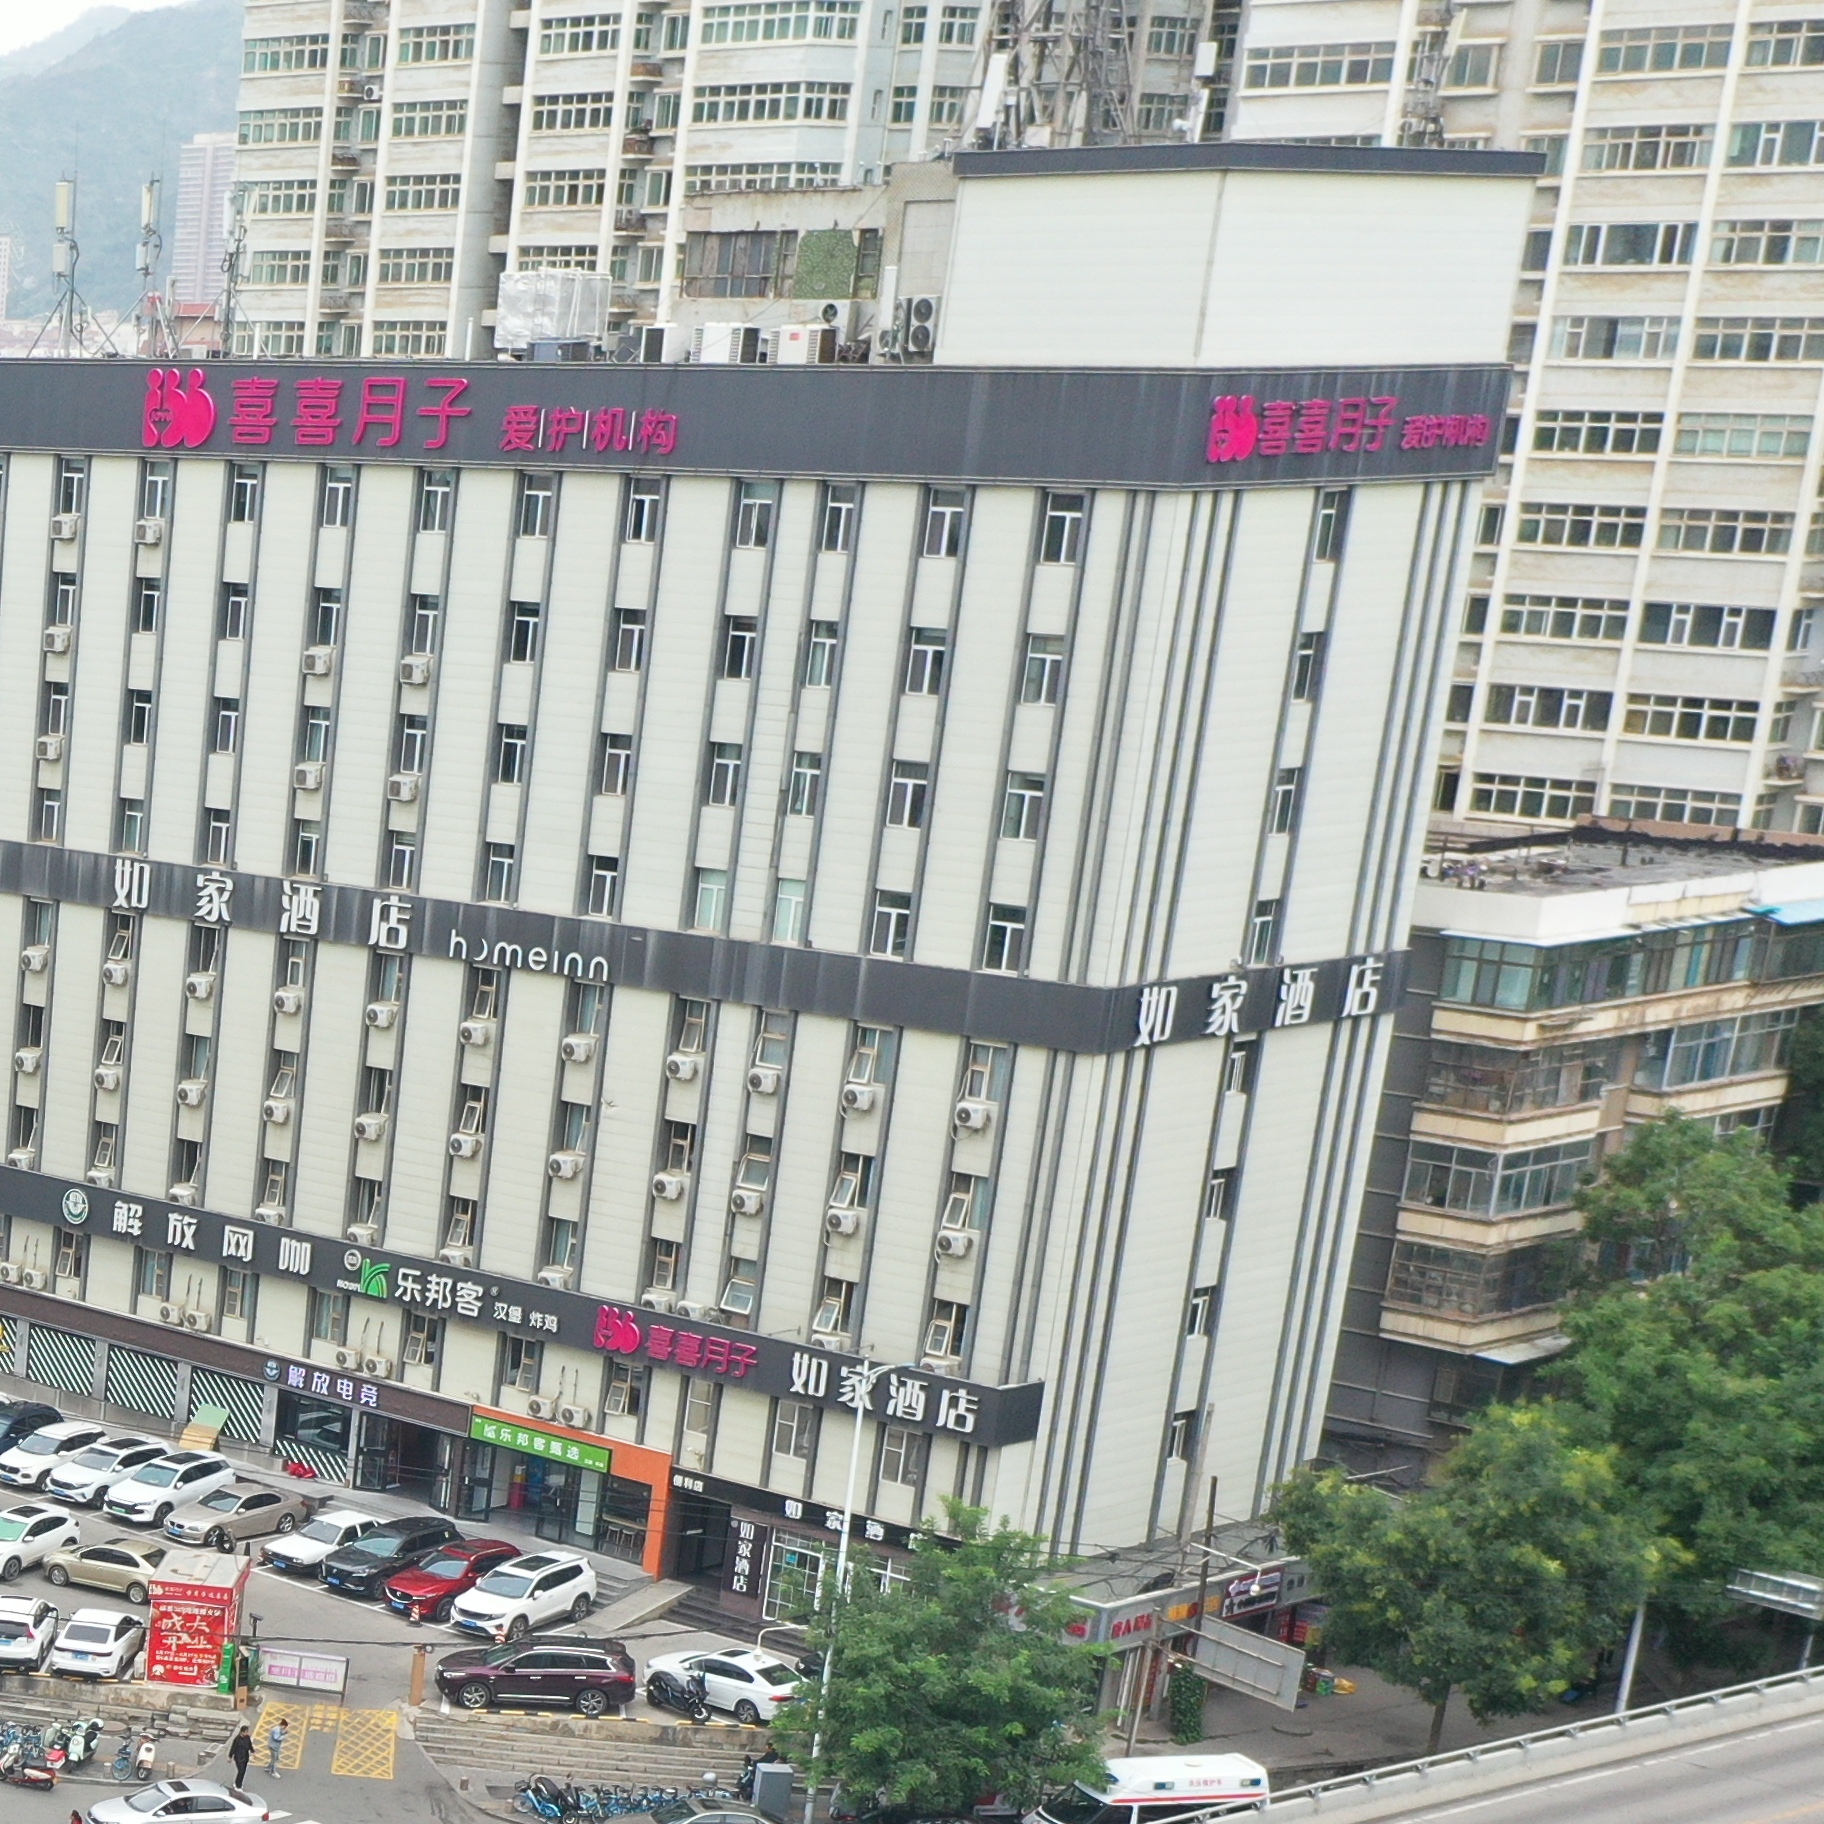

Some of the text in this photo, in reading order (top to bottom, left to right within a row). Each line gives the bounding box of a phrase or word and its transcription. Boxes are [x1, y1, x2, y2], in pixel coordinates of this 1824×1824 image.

[229, 376, 472, 449] 喜喜月子
[1258, 396, 1400, 455] 喜喜月子
[114, 858, 414, 950] 如家酒店
[1134, 957, 1383, 1047] 如家酒店
[112, 1200, 312, 1276] 解放网咖
[395, 1267, 558, 1333] 乐邦客 汉堡 炸鸡
[645, 1324, 758, 1379] 喜喜月子
[790, 1351, 981, 1434] 如家酒店
[732, 1522, 755, 1593] 如家酒店
